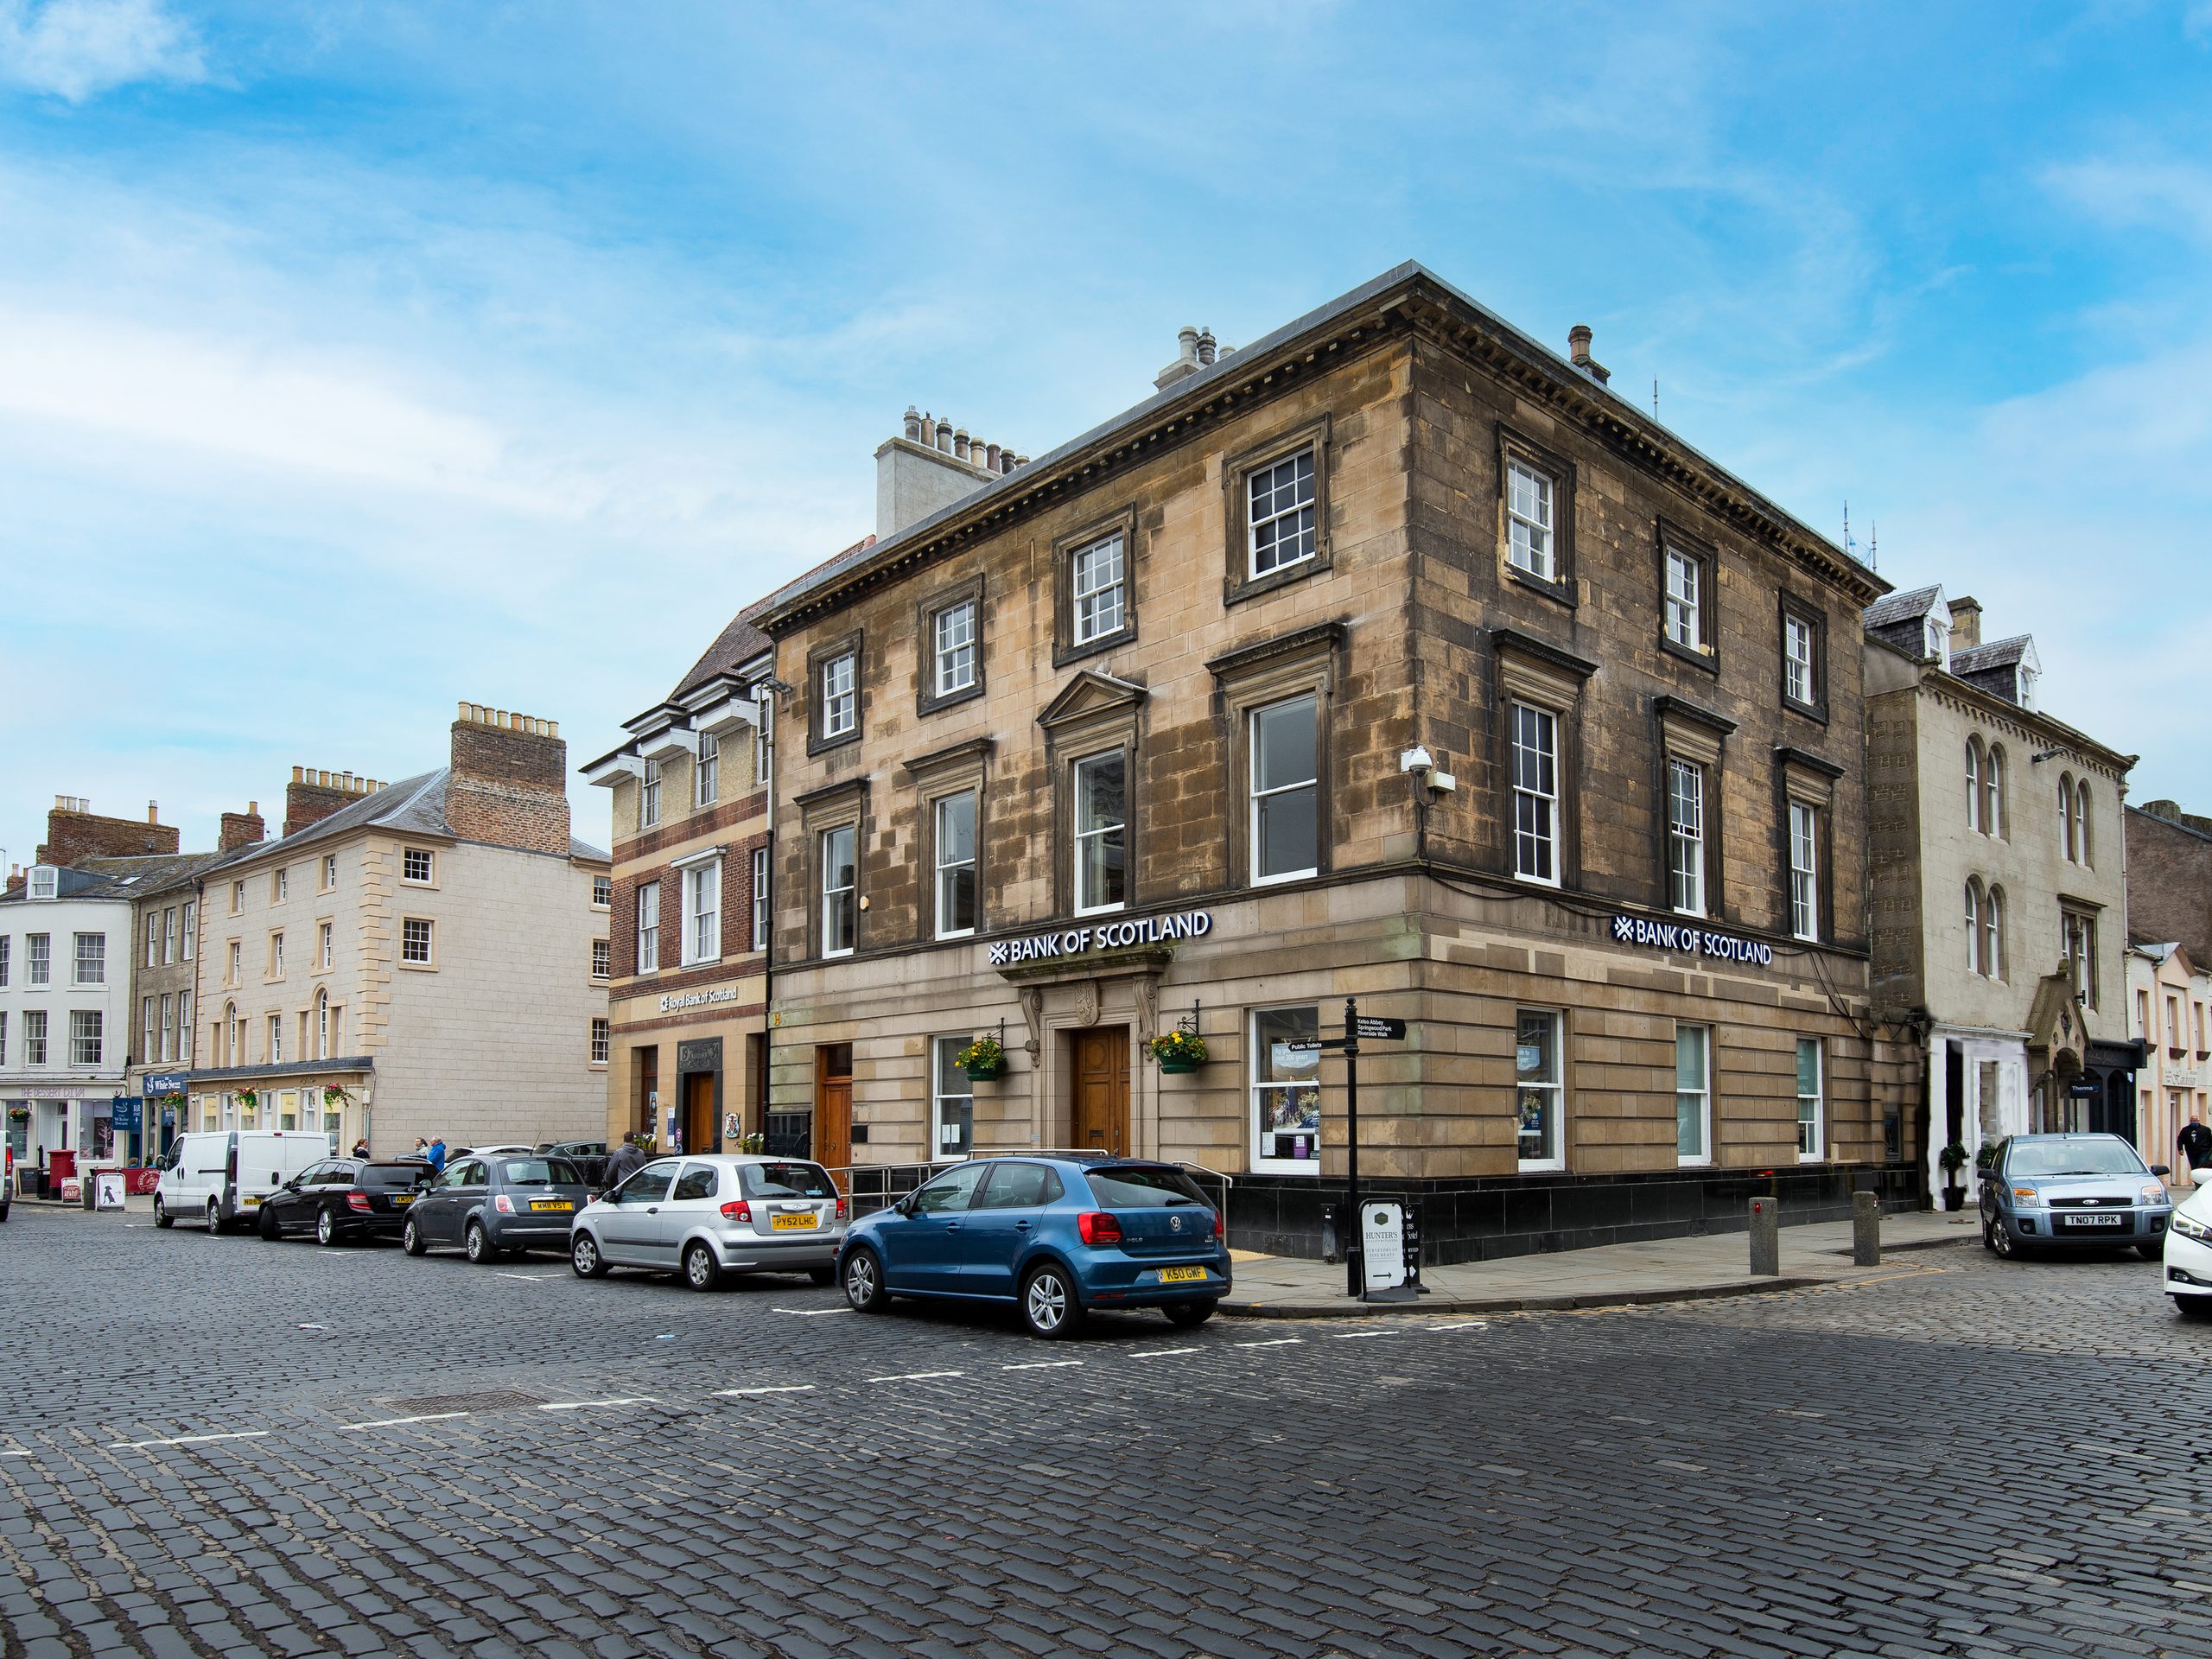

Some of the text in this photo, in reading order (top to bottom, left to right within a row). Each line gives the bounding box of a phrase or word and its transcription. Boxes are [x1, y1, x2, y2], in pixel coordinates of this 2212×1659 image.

[1012, 912, 1211, 962] BANK OF SCOTLAND
[1637, 919, 1772, 965] BANK OF SCOTLAND
[669, 986, 738, 1011] Royal Bank of Scotland
[155, 1079, 181, 1090] White Swan
[21, 1088, 85, 1097] THE DESSERT DIVA
[776, 1217, 814, 1226] PY52 LHC
[1166, 1267, 1201, 1280] K50 GWF
